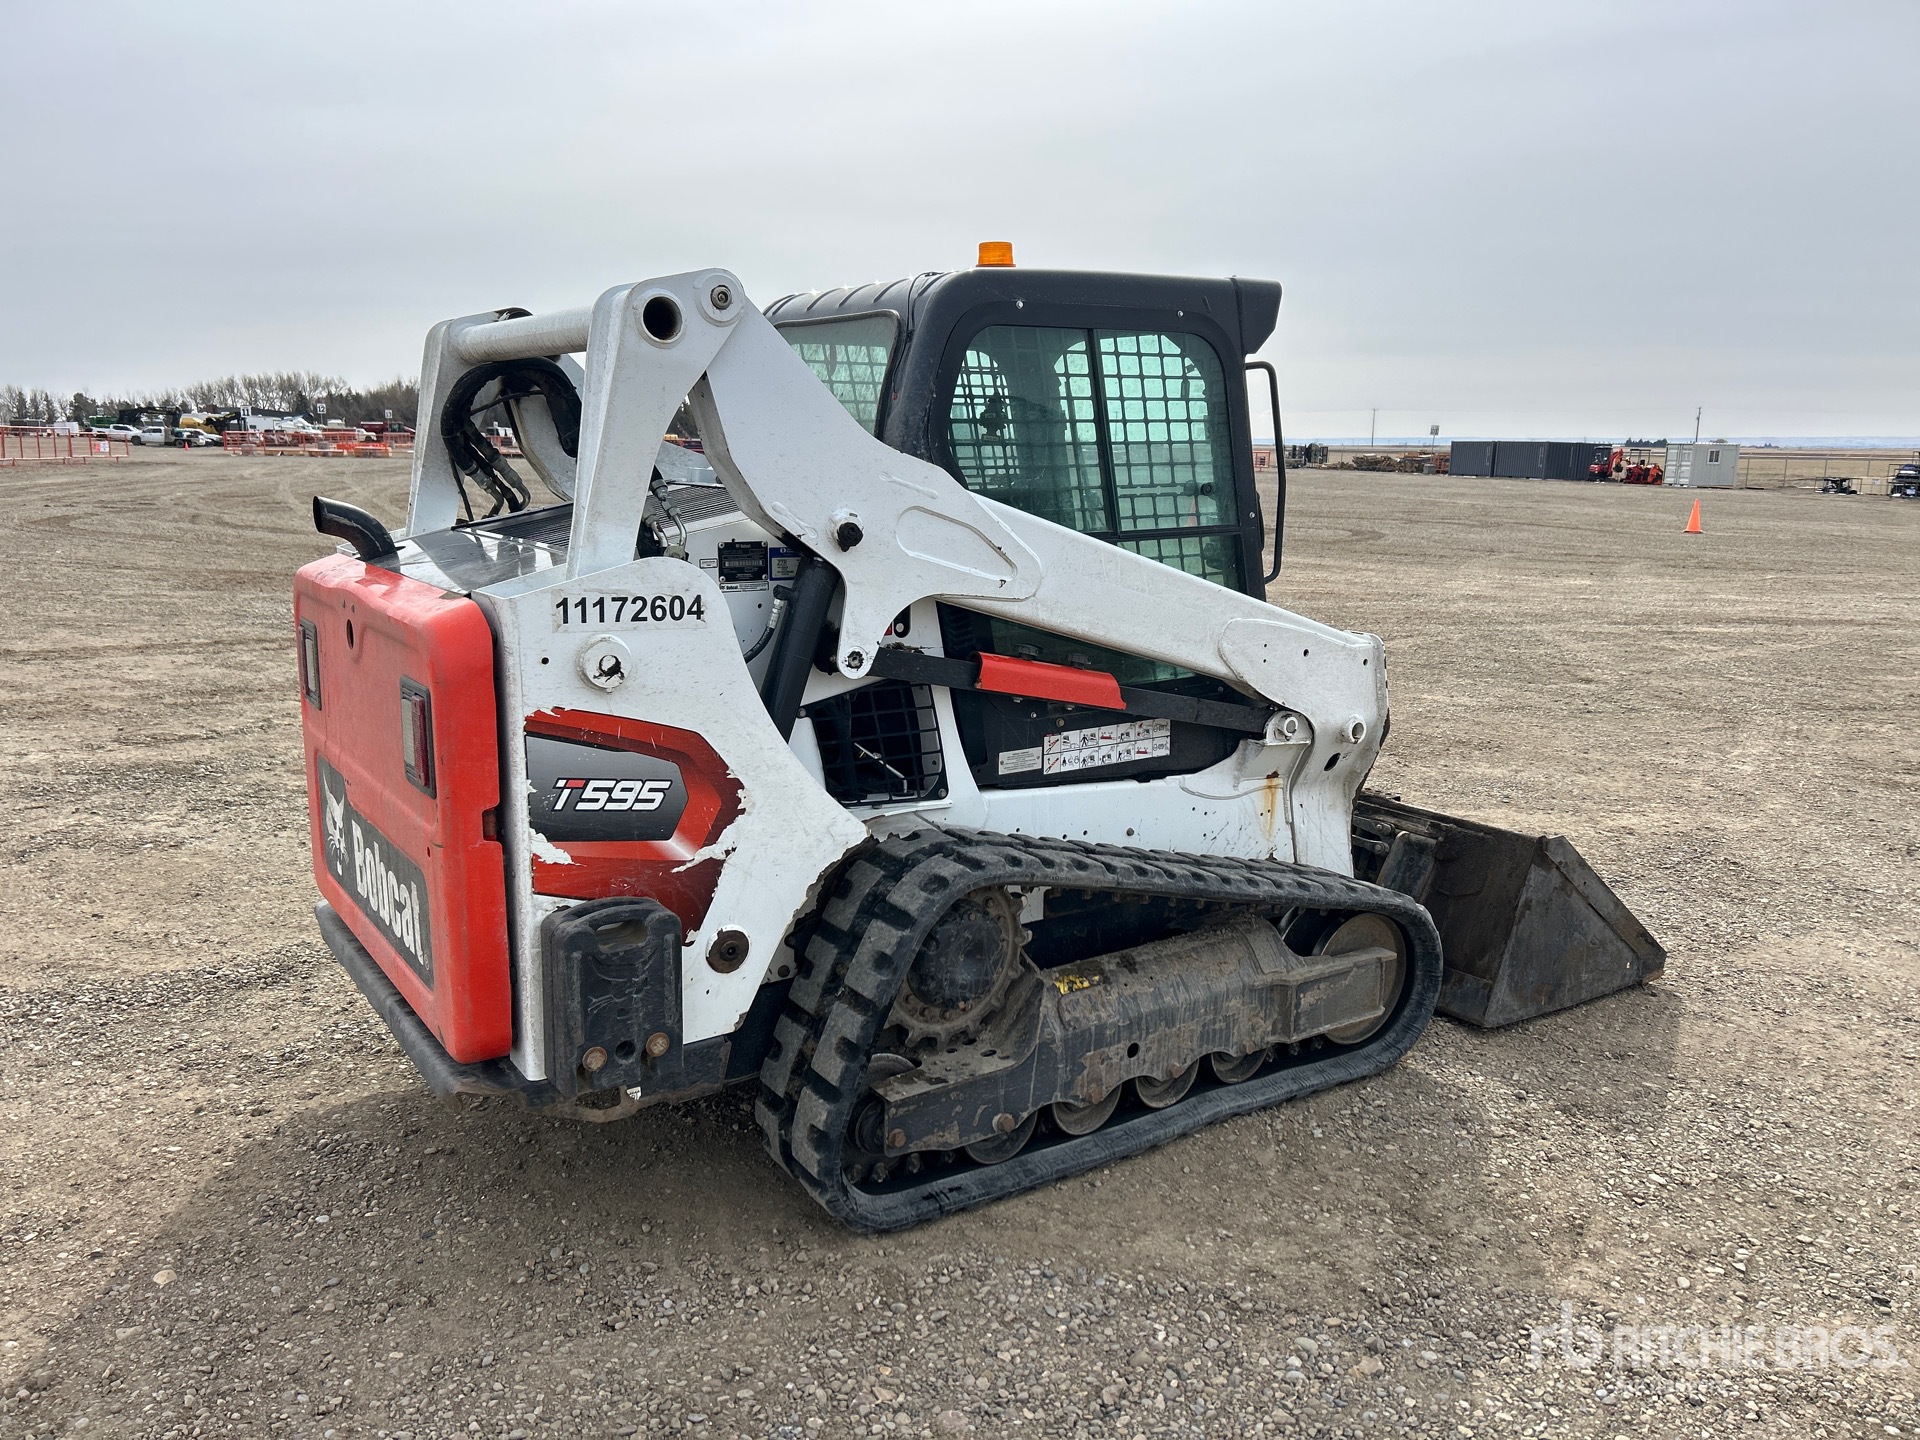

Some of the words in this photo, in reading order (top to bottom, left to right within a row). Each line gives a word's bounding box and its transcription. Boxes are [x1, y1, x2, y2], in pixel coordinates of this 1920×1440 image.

[555, 594, 705, 625] 11172604
[552, 778, 673, 811] T595
[351, 818, 424, 966] Bobcat
